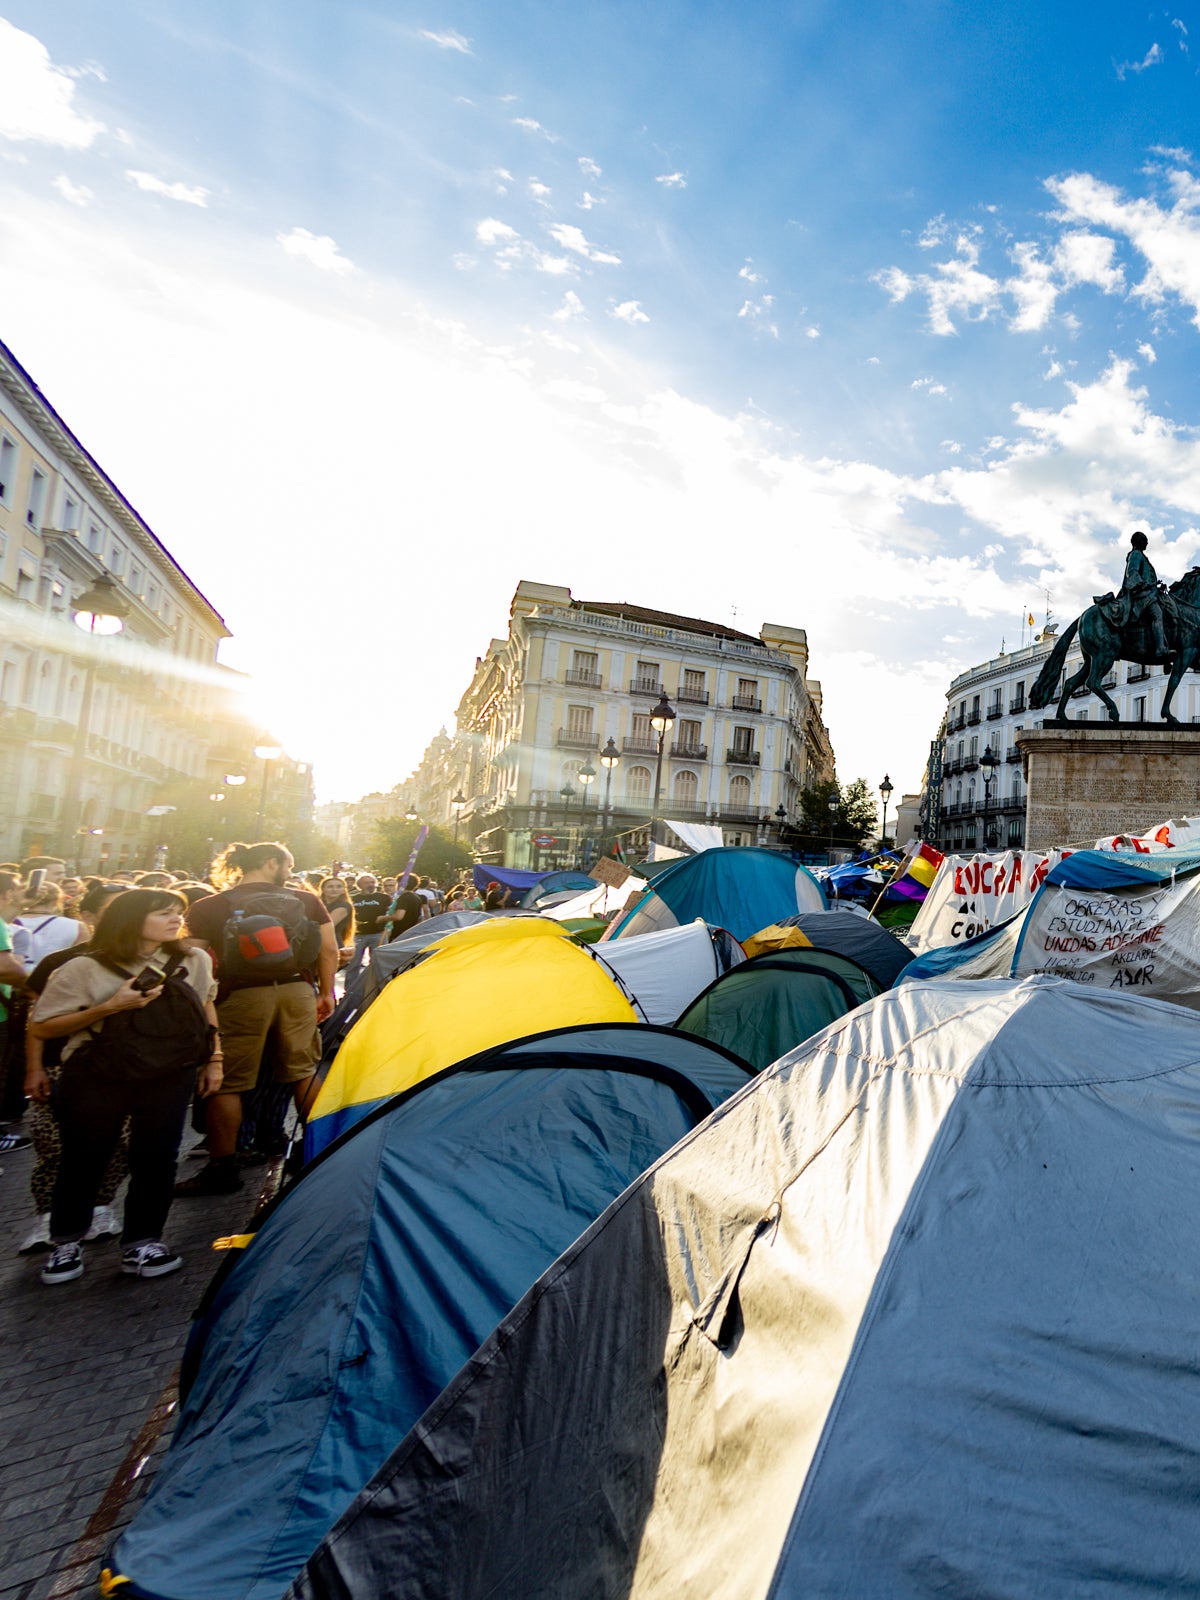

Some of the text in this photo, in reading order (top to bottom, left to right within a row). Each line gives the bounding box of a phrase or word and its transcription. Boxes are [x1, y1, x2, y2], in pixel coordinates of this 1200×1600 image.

[928, 741, 940, 839] HOTEL MODERNO
[955, 857, 1022, 896] LUCHA
[1064, 899, 1143, 917] OBRERAS
[1043, 935, 1097, 953] UNIDAS
